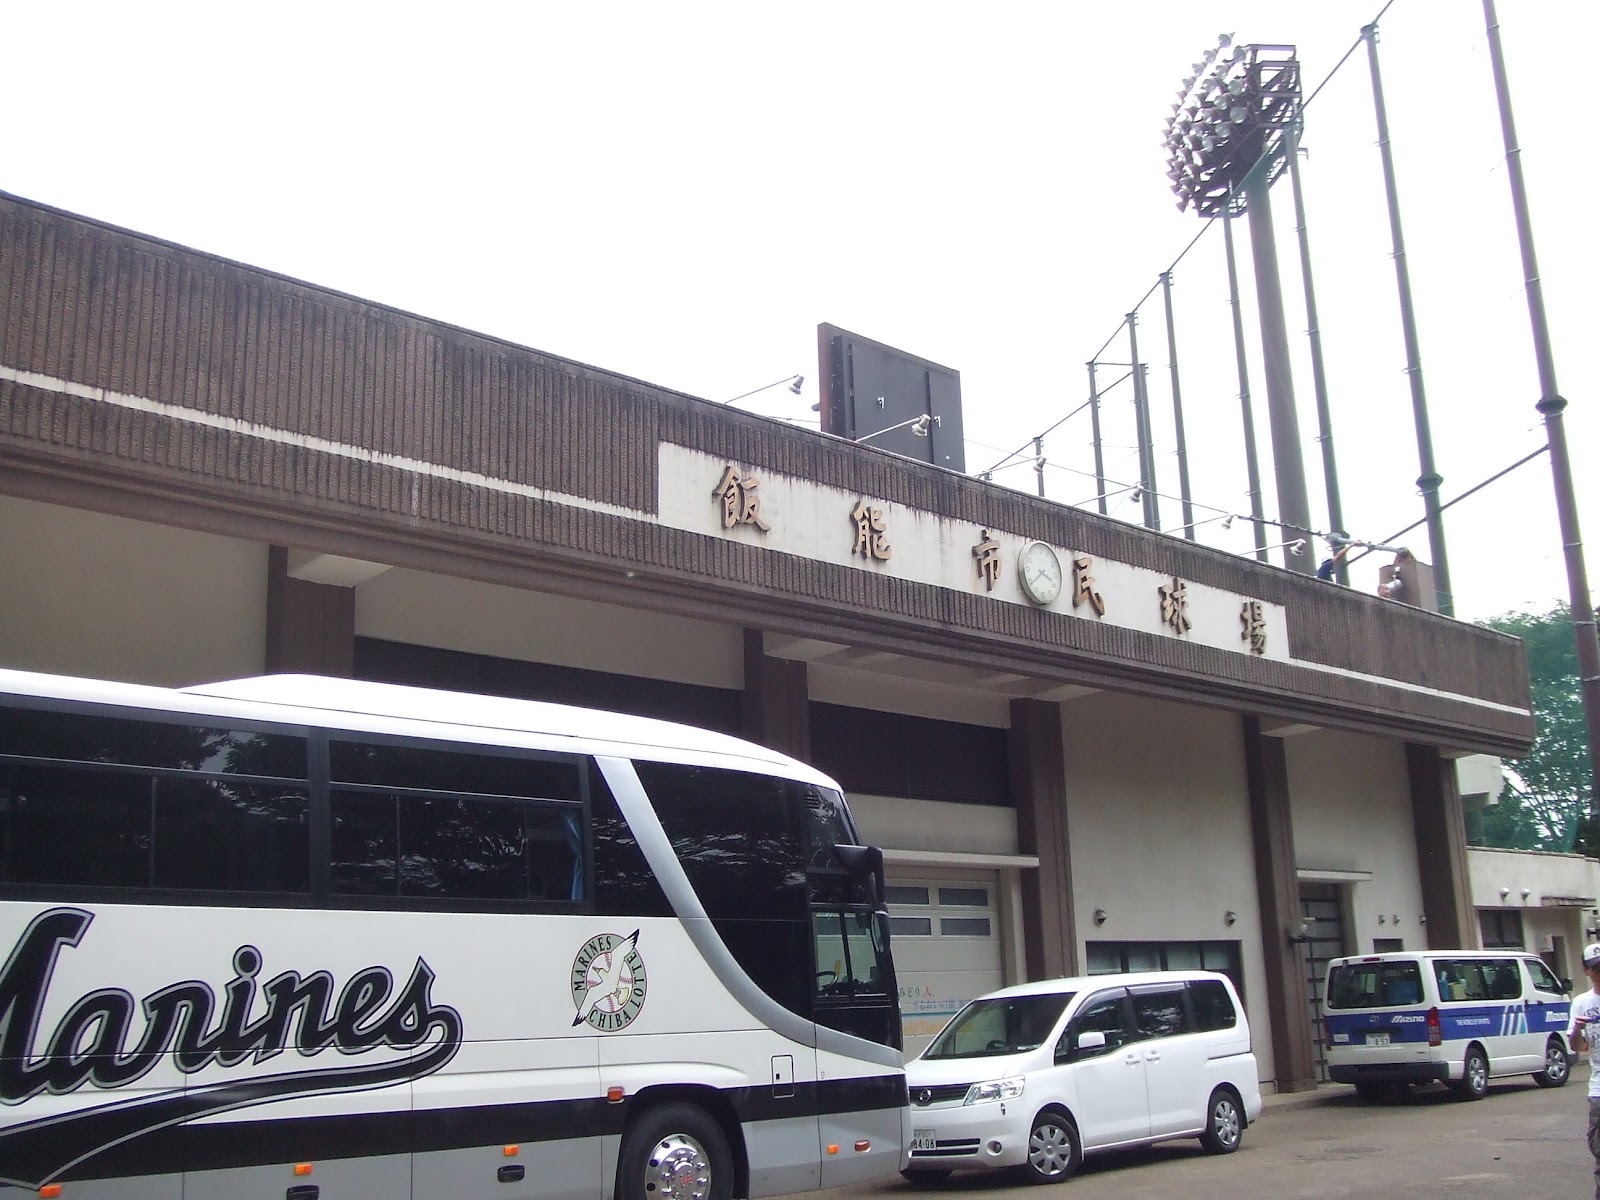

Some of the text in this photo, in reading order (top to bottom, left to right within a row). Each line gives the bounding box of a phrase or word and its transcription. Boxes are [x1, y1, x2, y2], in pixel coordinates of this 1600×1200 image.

[712, 466, 1266, 654] 飯能市民球場
[574, 936, 612, 991] MARINES
[589, 951, 645, 1029] CHIBA LOTTE
